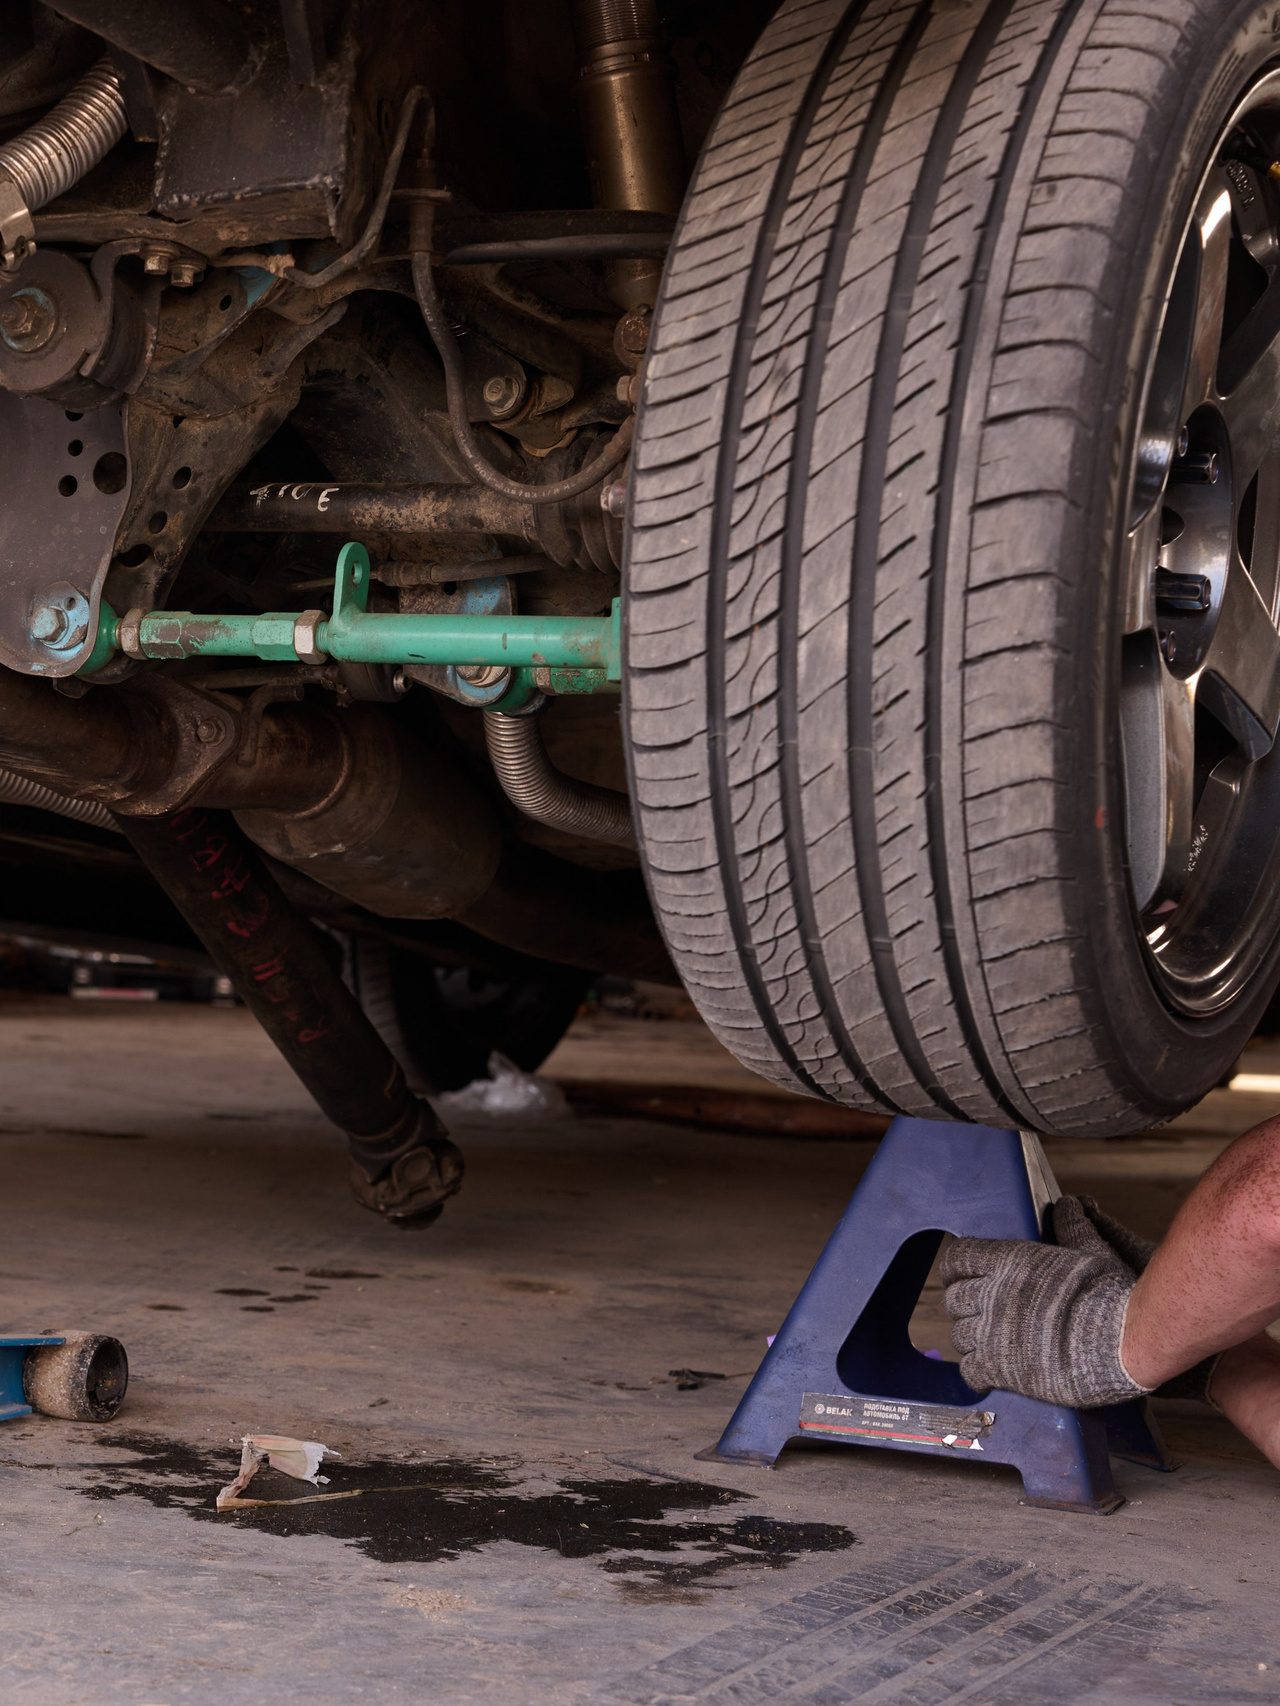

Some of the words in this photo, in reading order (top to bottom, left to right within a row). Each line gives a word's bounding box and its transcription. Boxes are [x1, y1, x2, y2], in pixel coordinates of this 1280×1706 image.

[826, 1406, 853, 1417] BELAK
[863, 1402, 896, 1413] ПОДСТАВКА
[897, 1406, 909, 1414] ПОД
[863, 1410, 900, 1420] АВТОМОБИЛЬ
